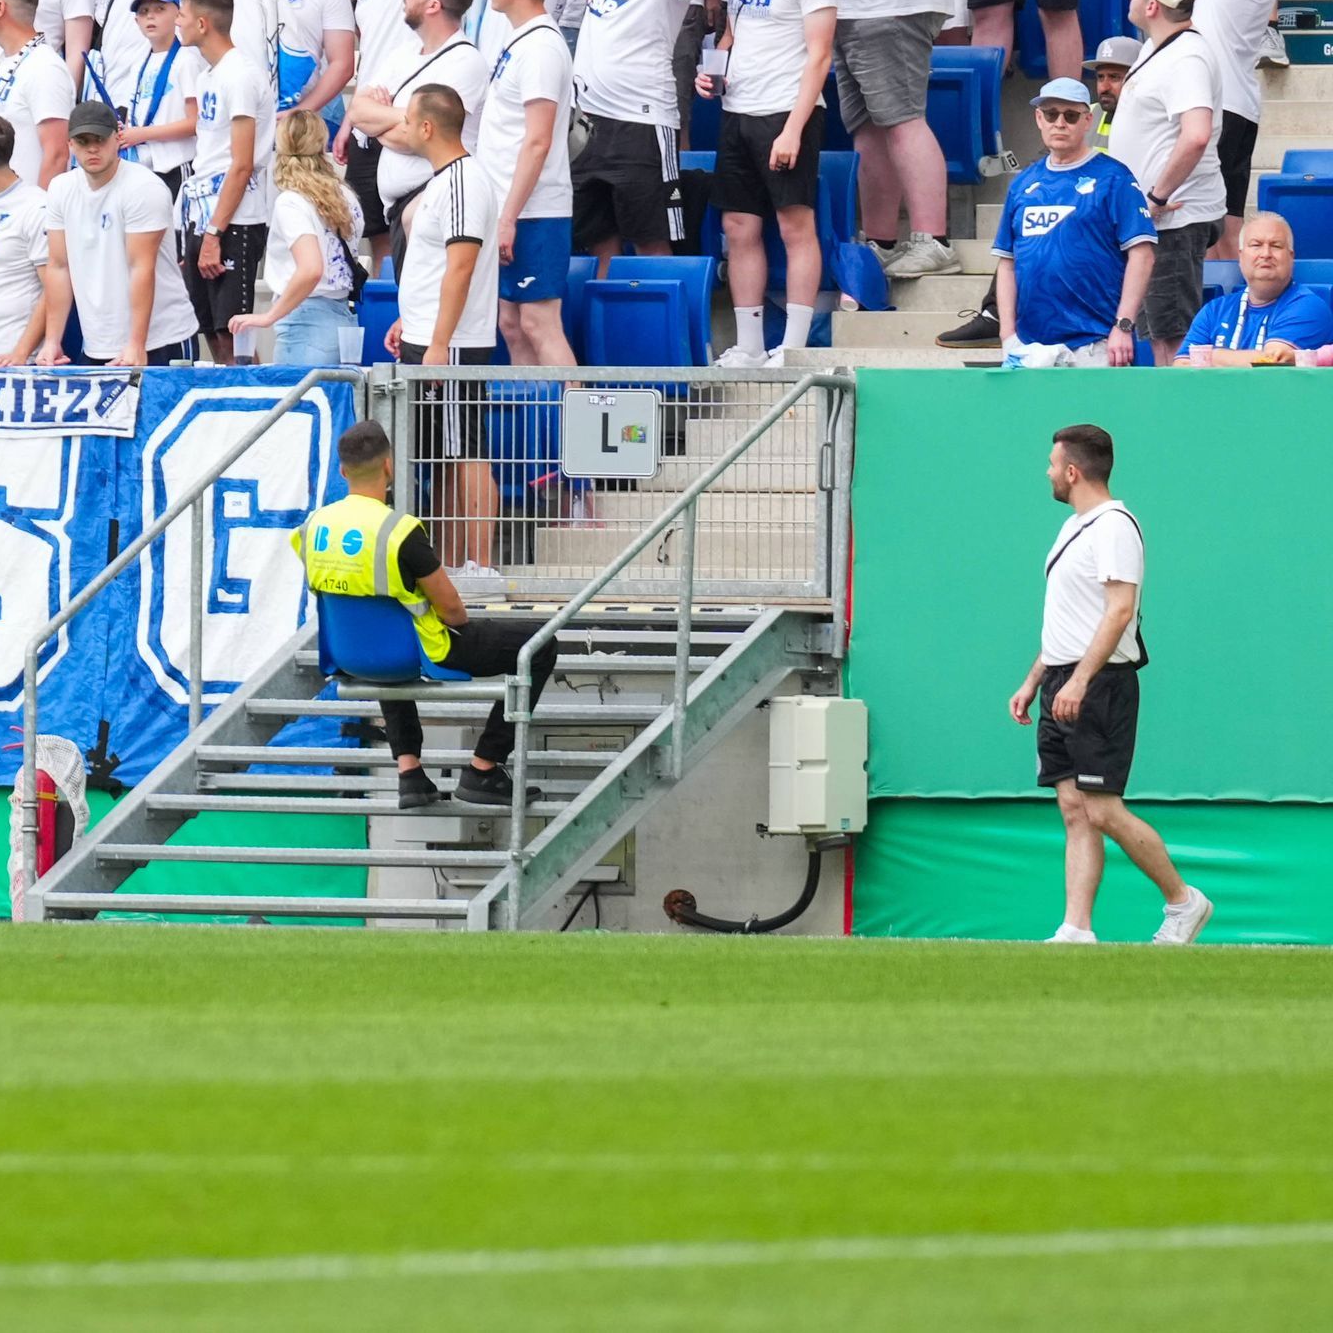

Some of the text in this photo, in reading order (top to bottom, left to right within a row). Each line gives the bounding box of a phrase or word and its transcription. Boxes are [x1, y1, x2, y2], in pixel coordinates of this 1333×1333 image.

[1024, 212, 1060, 230] SAP
[601, 411, 619, 454] L
[323, 577, 349, 593] 1740
